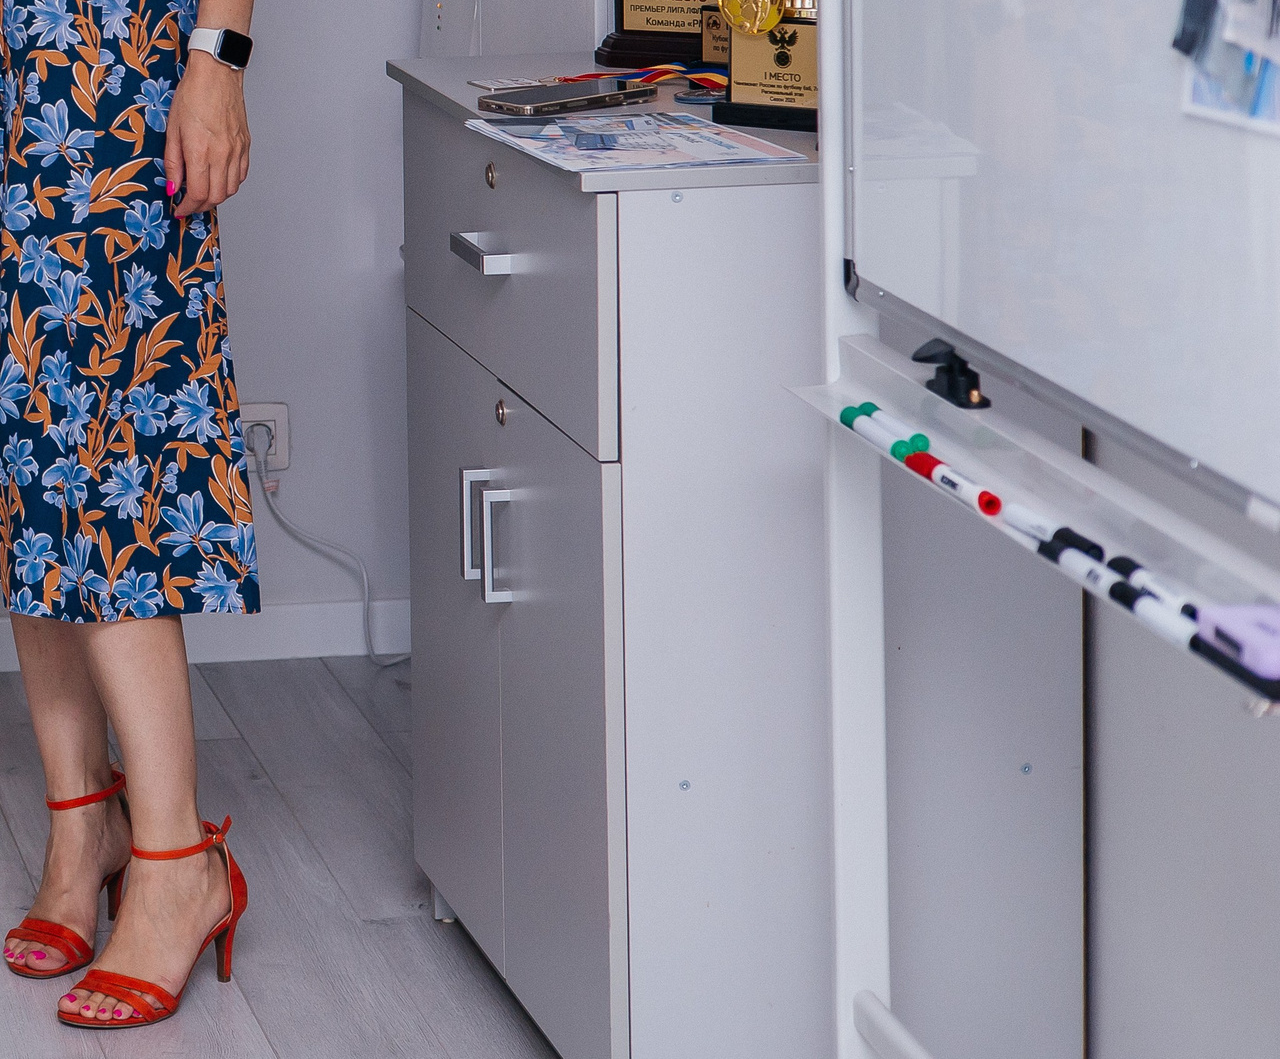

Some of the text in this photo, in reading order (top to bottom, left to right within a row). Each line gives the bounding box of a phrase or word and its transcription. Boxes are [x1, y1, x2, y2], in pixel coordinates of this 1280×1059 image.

[629, 4, 666, 14] ПРЕМЬЕР
[666, 5, 685, 15] ЛИГА
[645, 16, 686, 29] Команда
[769, 71, 802, 83] МЕСТО
